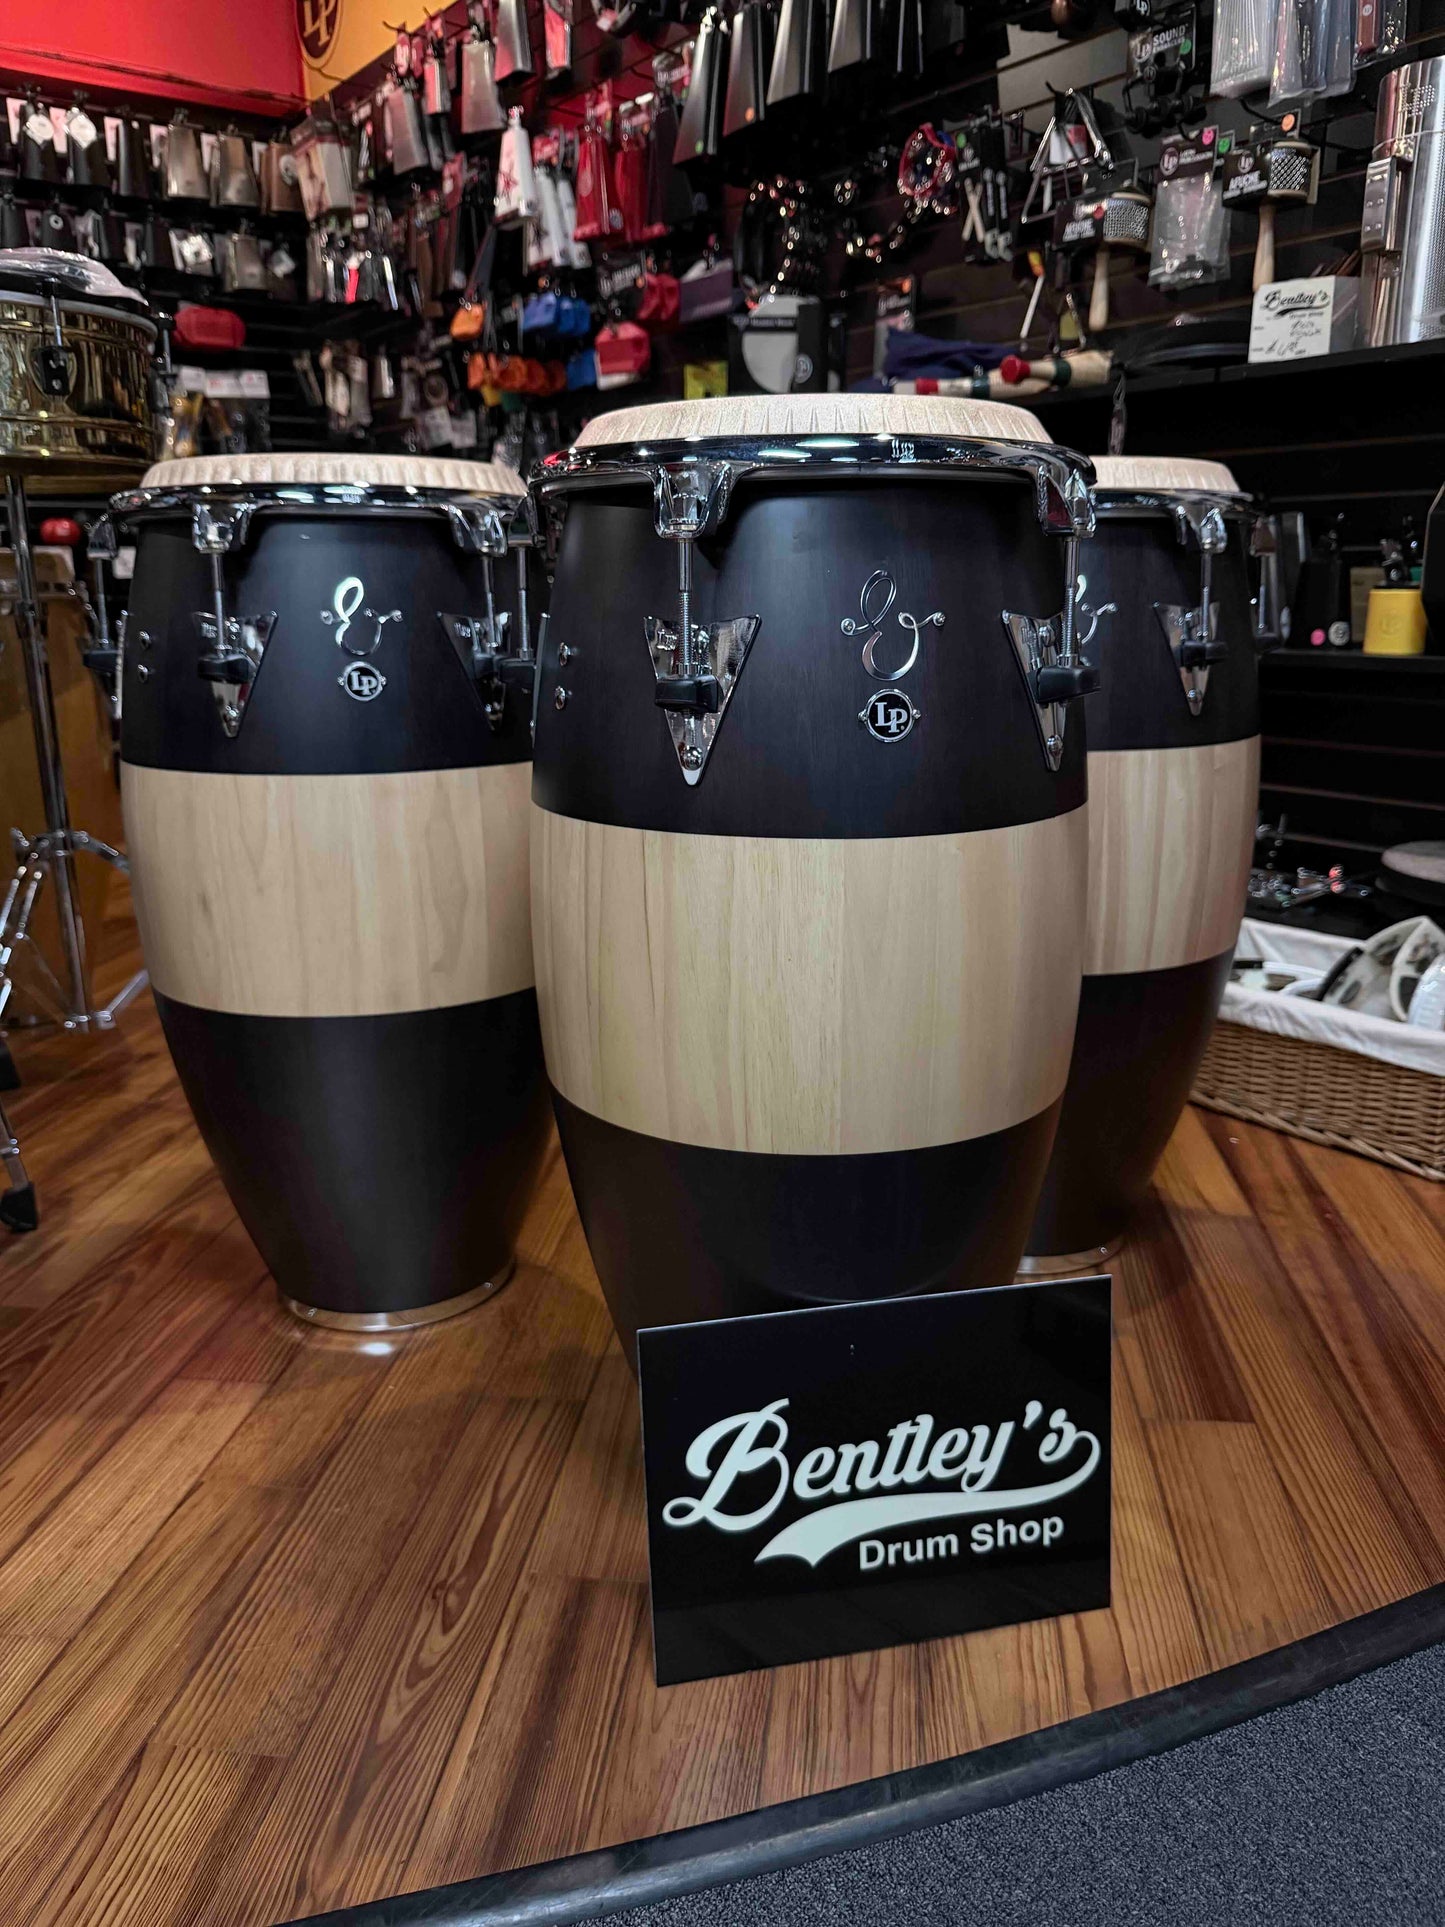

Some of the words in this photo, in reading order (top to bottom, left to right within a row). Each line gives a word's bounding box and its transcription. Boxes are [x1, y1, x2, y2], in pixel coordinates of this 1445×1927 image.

[1152, 25, 1186, 47] SOUND
[350, 670, 378, 696] LP
[874, 701, 908, 734] LP
[662, 1398, 1085, 1532] Bentley's
[858, 1531, 959, 1571] Drum
[970, 1515, 1066, 1555] Shop
